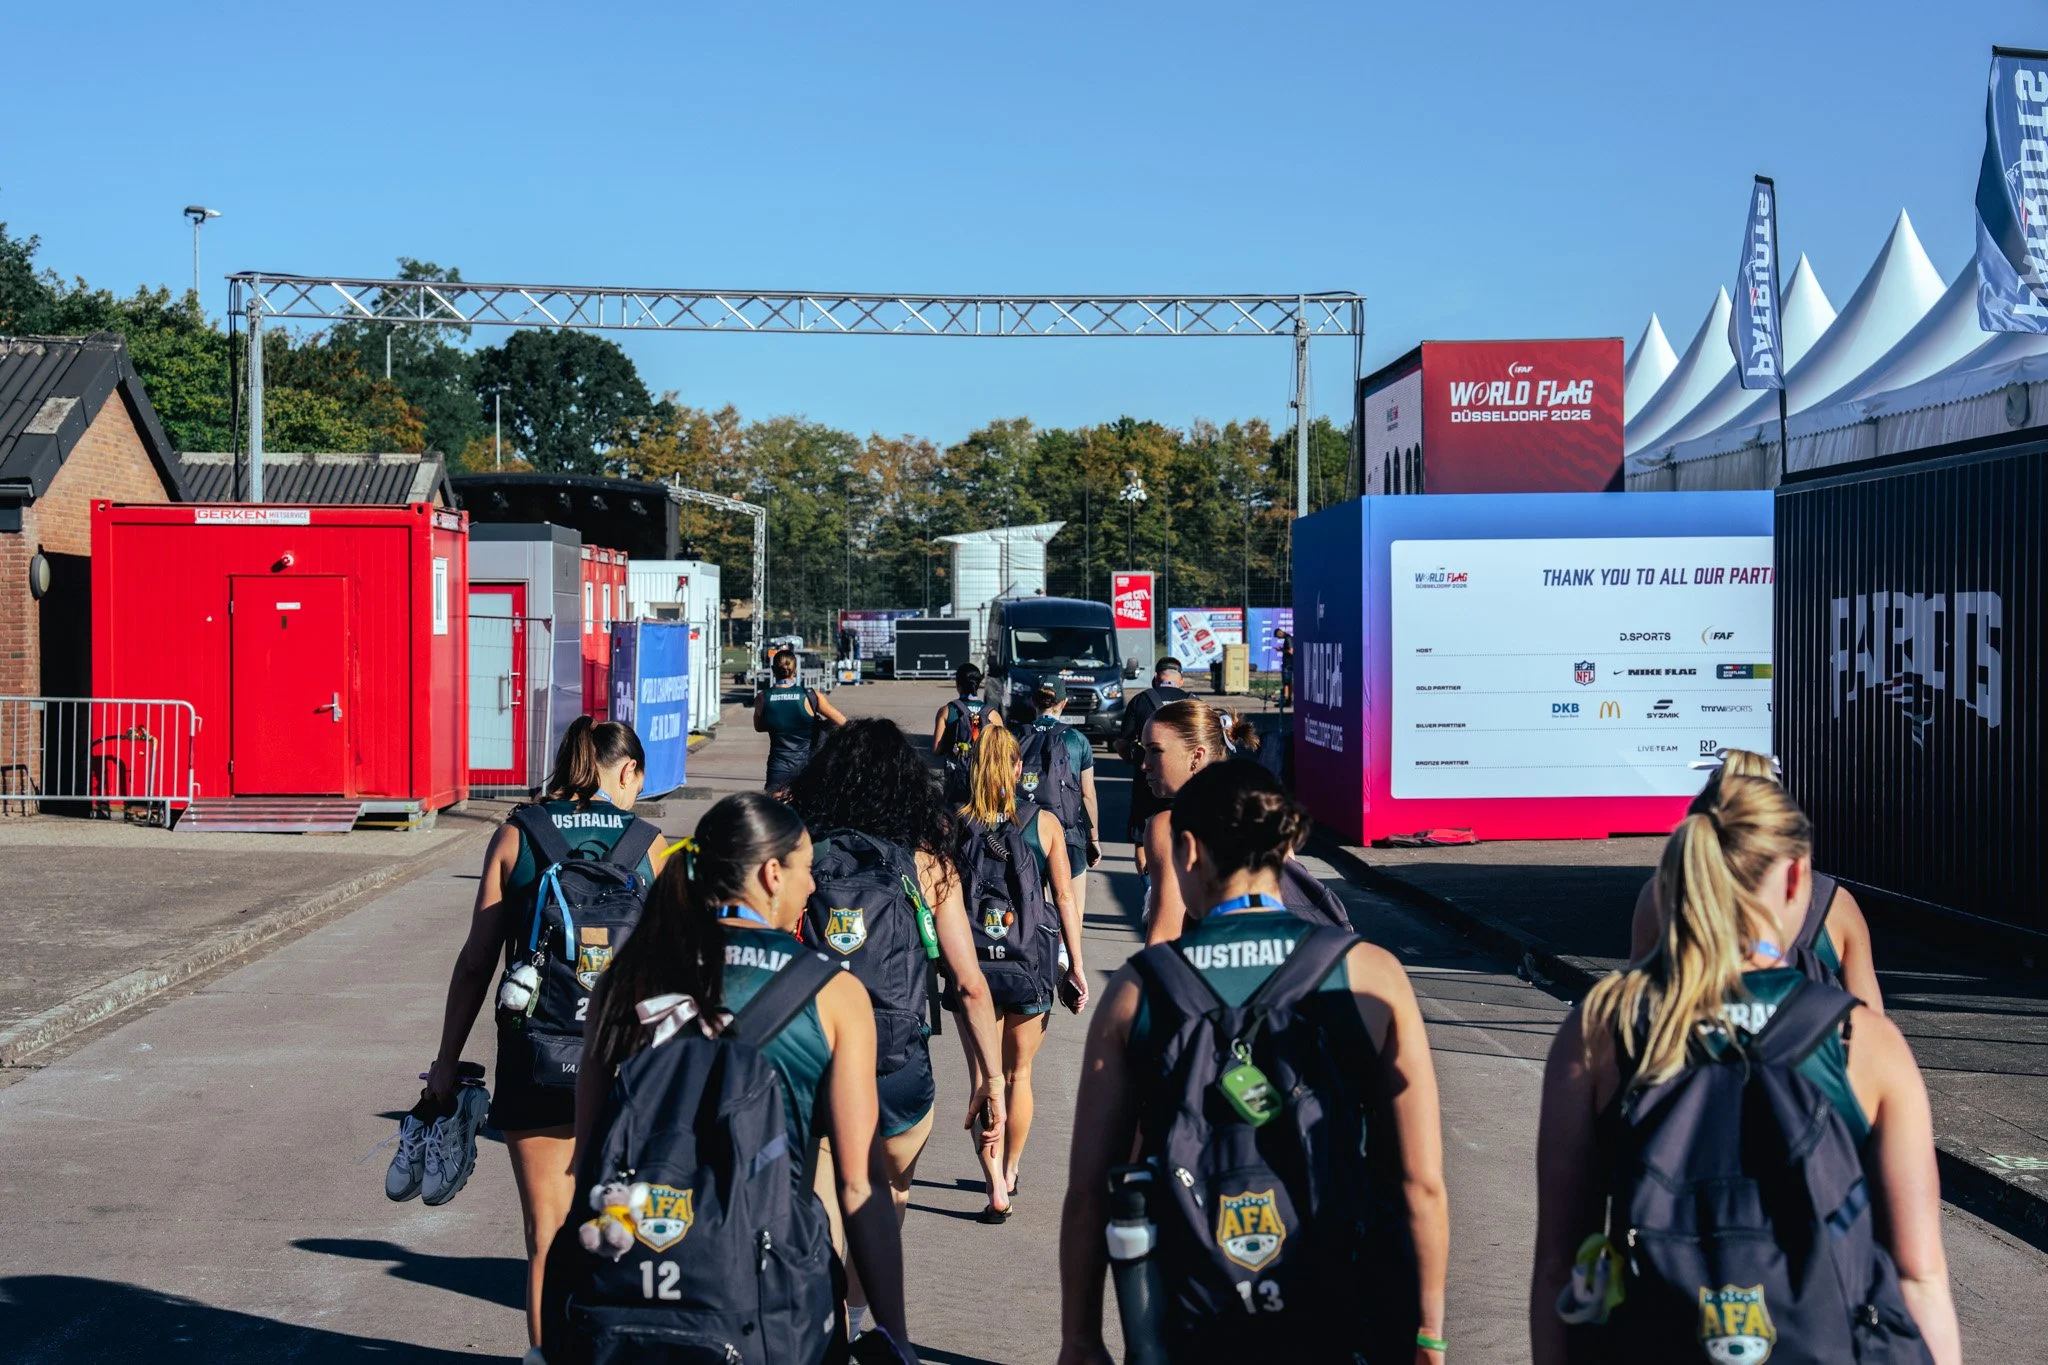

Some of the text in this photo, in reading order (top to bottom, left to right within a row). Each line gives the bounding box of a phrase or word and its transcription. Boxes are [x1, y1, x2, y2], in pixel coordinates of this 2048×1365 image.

[1450, 380, 1593, 407] WORLD FLAG
[1451, 409, 1592, 423] DÜSSELDORF 2026
[197, 511, 267, 520] GERKEN
[1543, 569, 1595, 586] THANK
[1601, 569, 1631, 586] YOU
[1637, 568, 1655, 585] TO
[1660, 568, 1688, 585] ALL
[1694, 567, 1724, 585] OUR
[1123, 600, 1142, 609] OUR
[1619, 632, 1671, 641] D.SPORTS
[1576, 671, 1593, 682] NFL
[1665, 668, 1697, 676] FLAG
[1552, 703, 1579, 713] DKB
[1700, 740, 1717, 752] RP
[552, 813, 624, 829] USTRALIA
[984, 914, 1002, 926] AF
[988, 945, 1006, 960] 16
[1223, 1205, 1280, 1240] AFA
[640, 1260, 681, 1300] 12
[1236, 1280, 1284, 1314] 13
[1703, 1302, 1769, 1337] AFA
